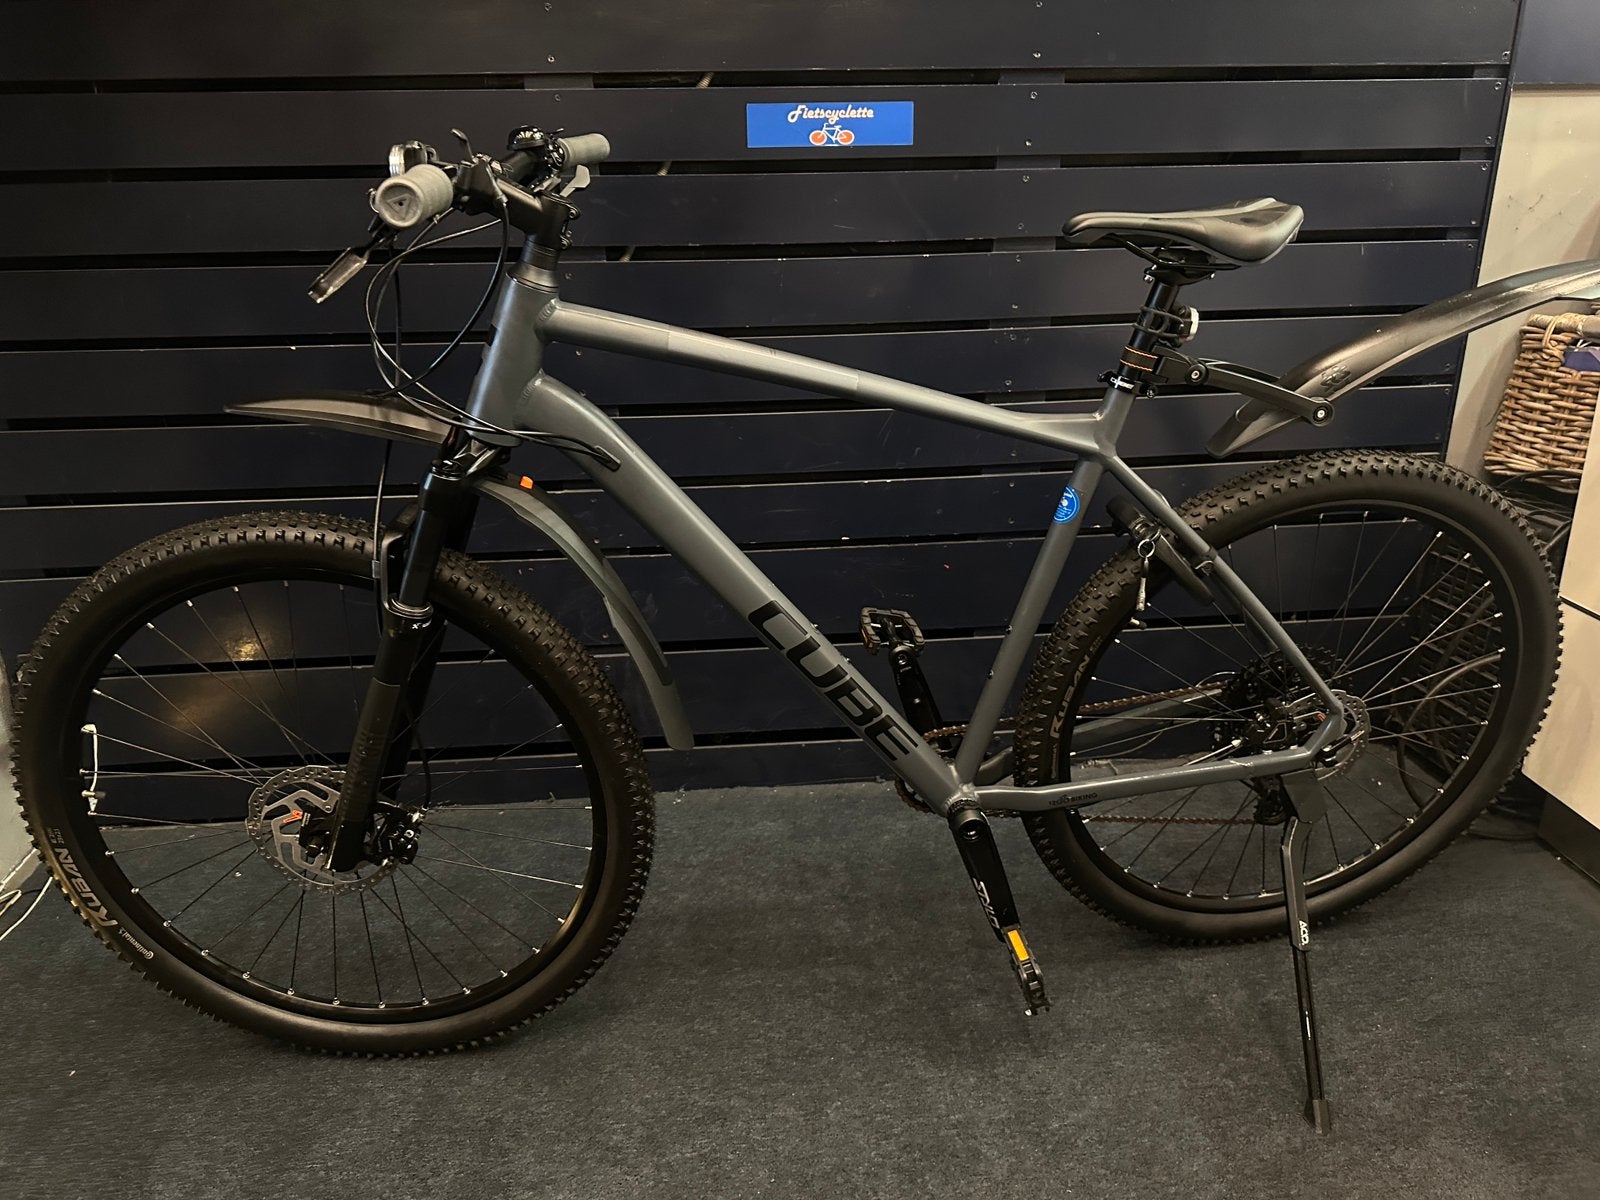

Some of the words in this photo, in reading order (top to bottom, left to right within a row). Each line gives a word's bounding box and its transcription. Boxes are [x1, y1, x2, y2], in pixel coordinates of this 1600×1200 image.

[787, 104, 874, 124] Fietscyclette
[748, 600, 919, 761] CUBE
[54, 847, 118, 927] RUBAN
[121, 929, 154, 960] Continental
